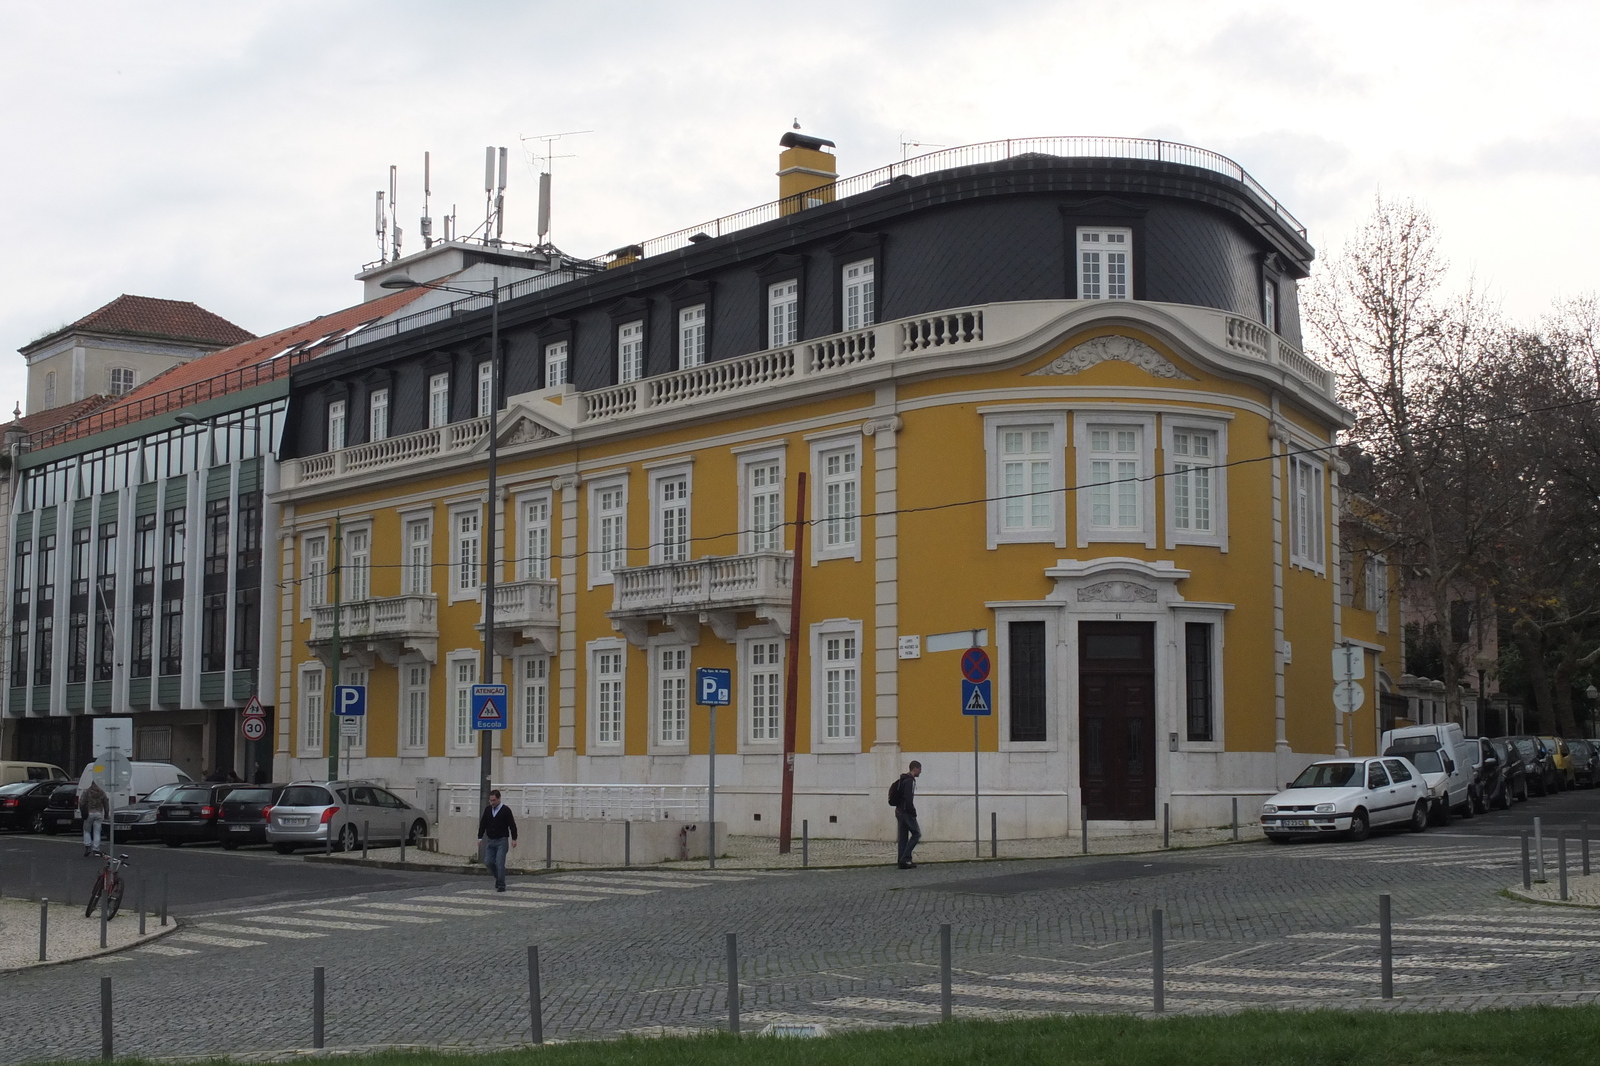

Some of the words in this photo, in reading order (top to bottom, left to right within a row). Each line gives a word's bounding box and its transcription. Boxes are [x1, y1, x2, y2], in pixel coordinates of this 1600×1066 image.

[703, 679, 717, 700] P
[341, 688, 359, 713] P
[247, 723, 261, 733] 30
[477, 720, 502, 728] Escola
